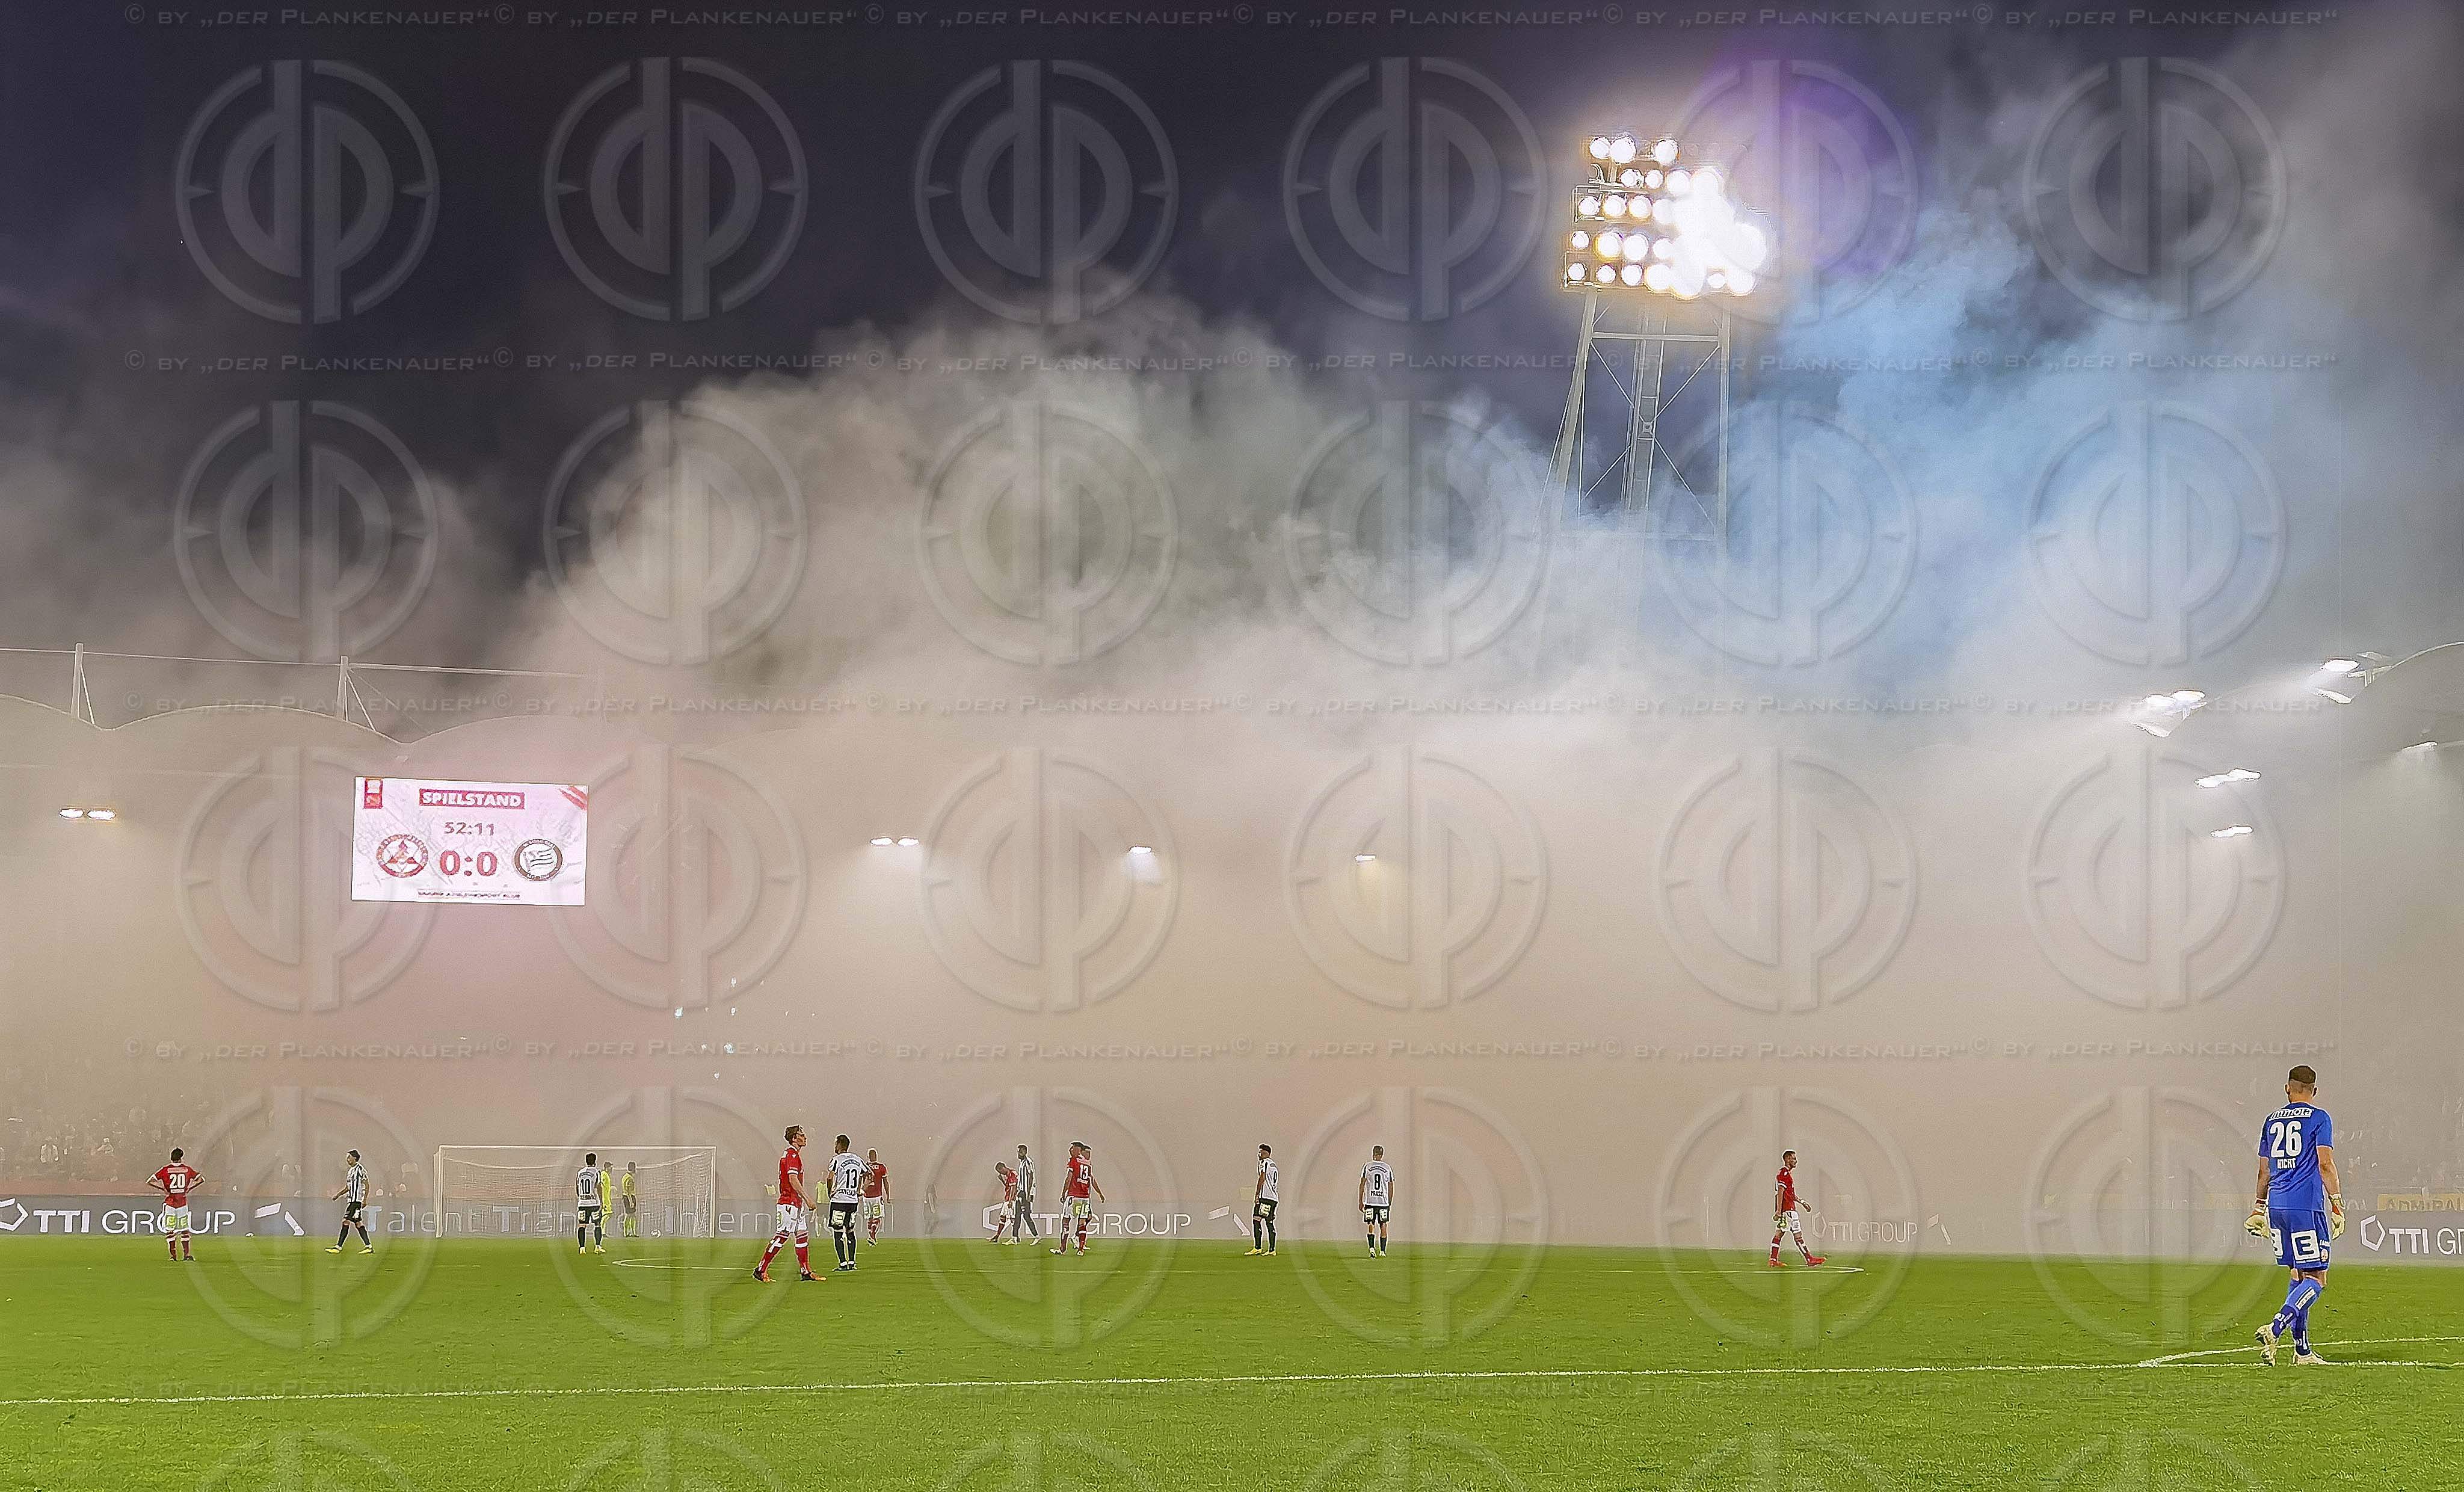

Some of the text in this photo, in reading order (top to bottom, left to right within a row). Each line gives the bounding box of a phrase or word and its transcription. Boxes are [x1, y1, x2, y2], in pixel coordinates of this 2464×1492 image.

[422, 792, 522, 807] SPIELSTAND
[444, 821, 494, 836] 52:11
[440, 850, 498, 877] 0:0
[2270, 1121, 2302, 1158] 26
[169, 1174, 185, 1189] 20
[846, 1169, 857, 1189] 13
[1080, 1165, 1089, 1180] 13
[1374, 1173, 1381, 1191] 8
[581, 1179, 591, 1194] 10
[34, 1210, 90, 1233] TTI
[1858, 1220, 1918, 1243] GROUP
[2389, 1228, 2429, 1254] TTI
